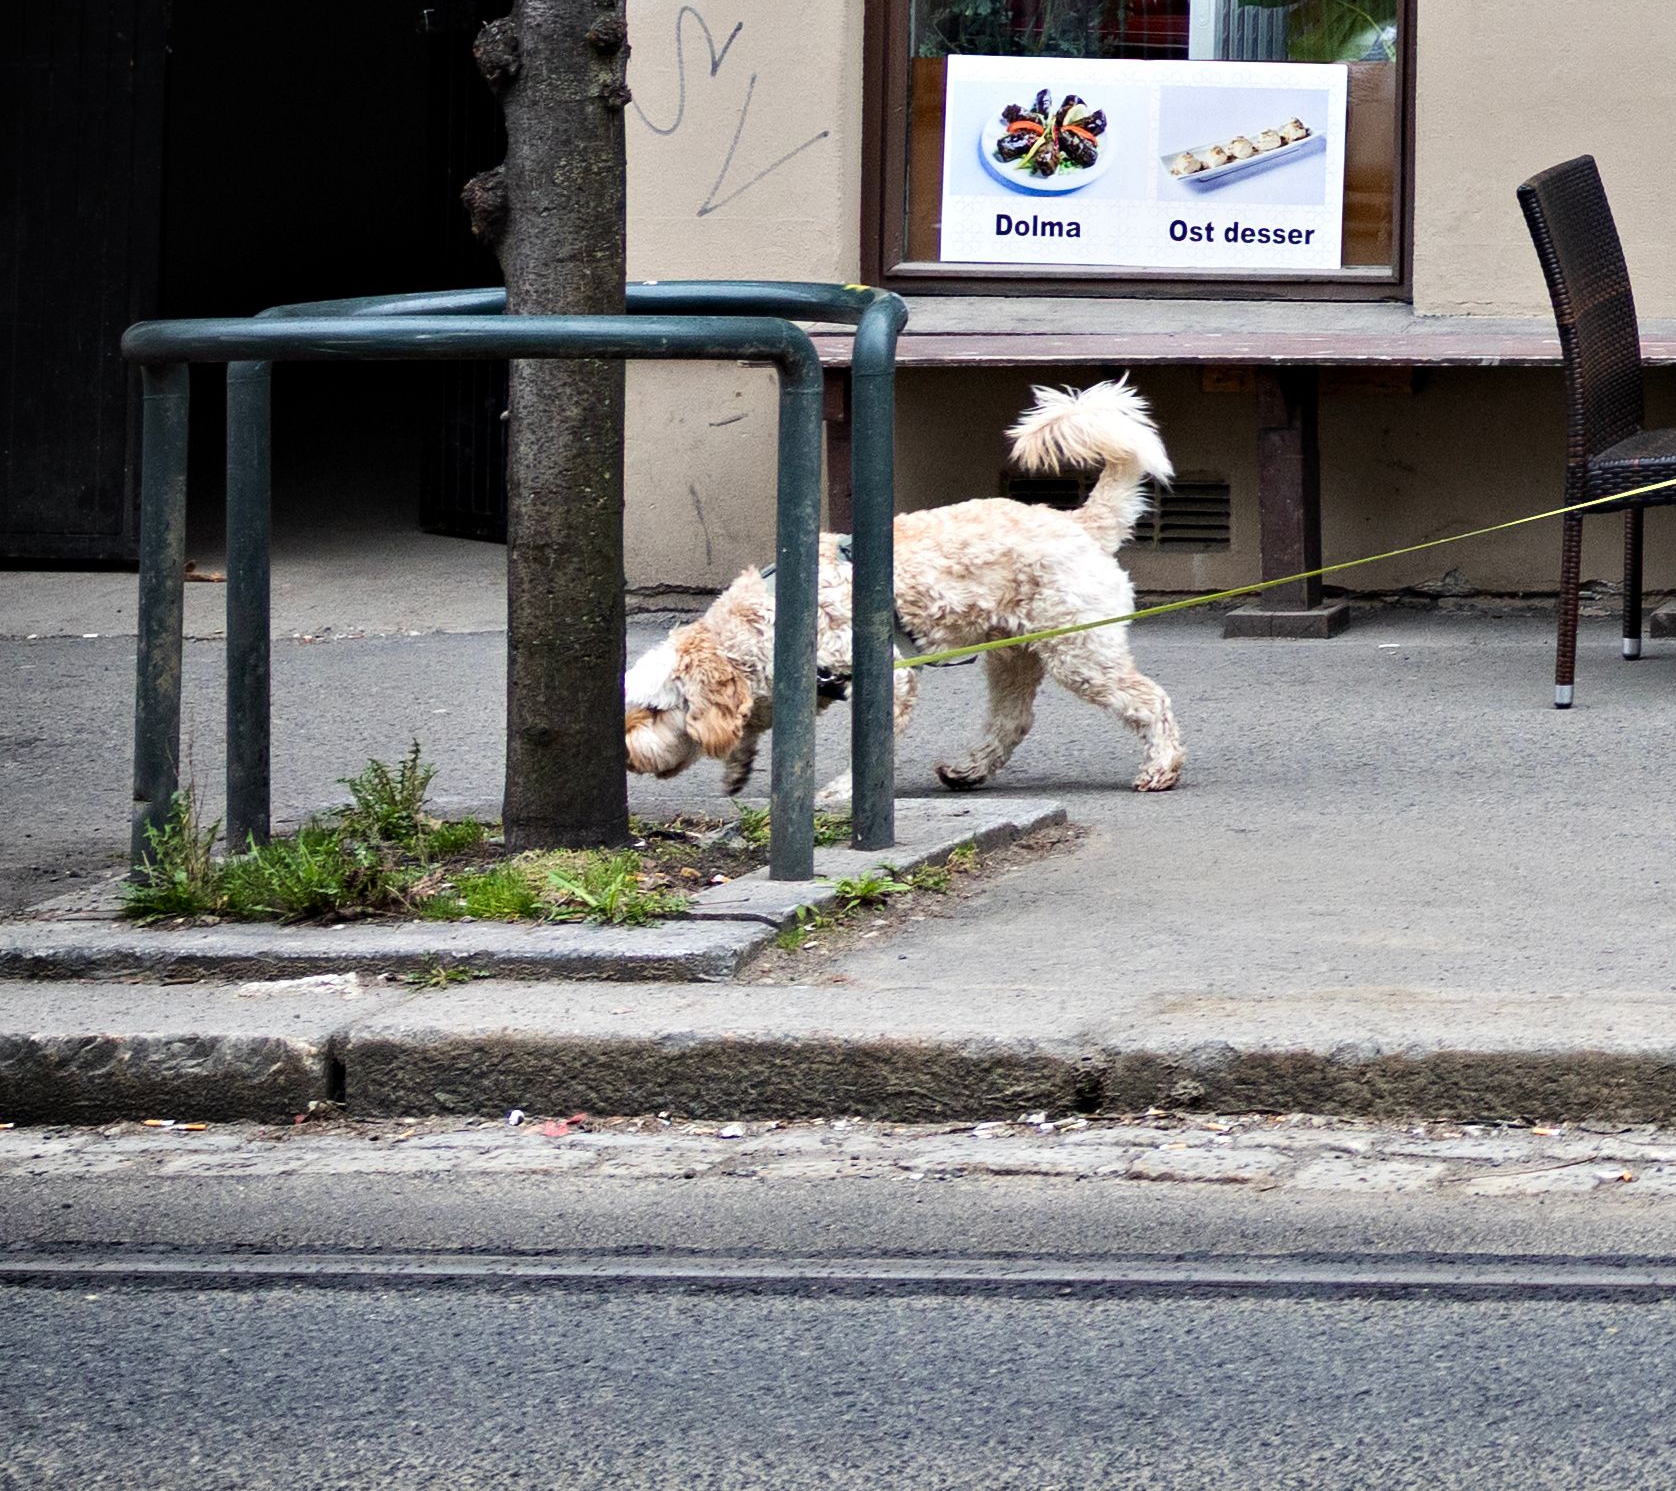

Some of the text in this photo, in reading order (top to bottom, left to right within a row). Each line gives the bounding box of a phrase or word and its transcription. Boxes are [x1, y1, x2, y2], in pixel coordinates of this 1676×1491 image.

[995, 213, 1081, 238] Dolma
[1169, 219, 1316, 245] Ost desser
